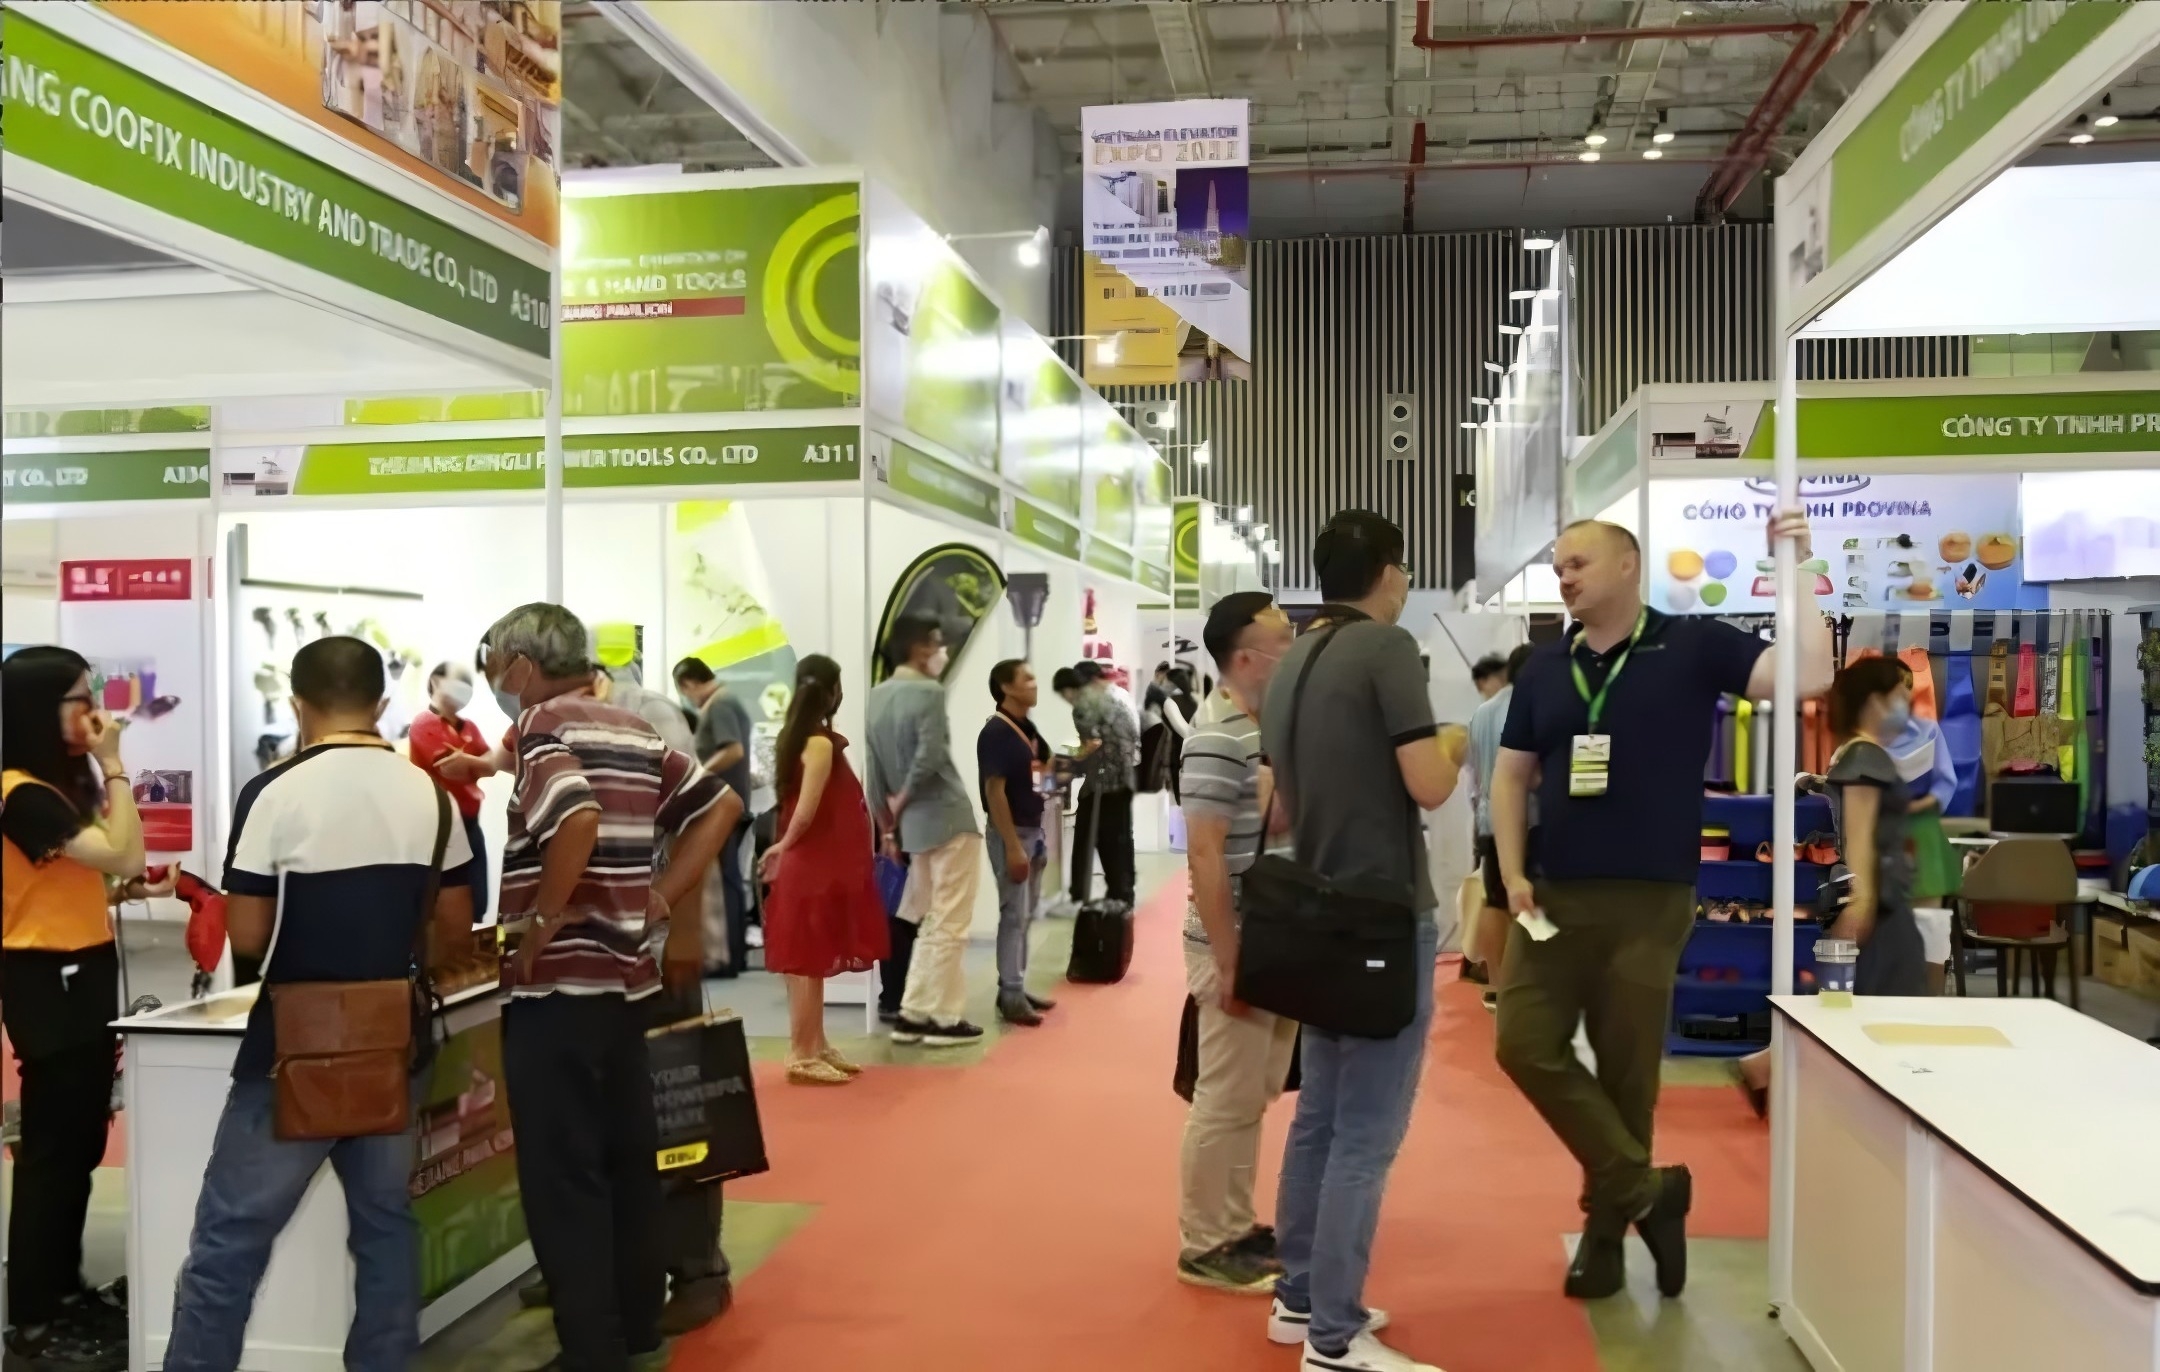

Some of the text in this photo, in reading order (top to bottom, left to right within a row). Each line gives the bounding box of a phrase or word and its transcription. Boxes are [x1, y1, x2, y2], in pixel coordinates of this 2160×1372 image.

[70, 87, 182, 170] COOFIX
[190, 137, 315, 226] INDUSTRY
[318, 198, 366, 247] AND
[368, 220, 432, 278] TRADE
[469, 264, 499, 304] LTD
[673, 268, 747, 291] TOOLS
[2013, 416, 2049, 436] TY
[2052, 414, 2124, 435] TNHH
[608, 446, 675, 467] TOOLS
[1842, 501, 1932, 519] PROVINA
